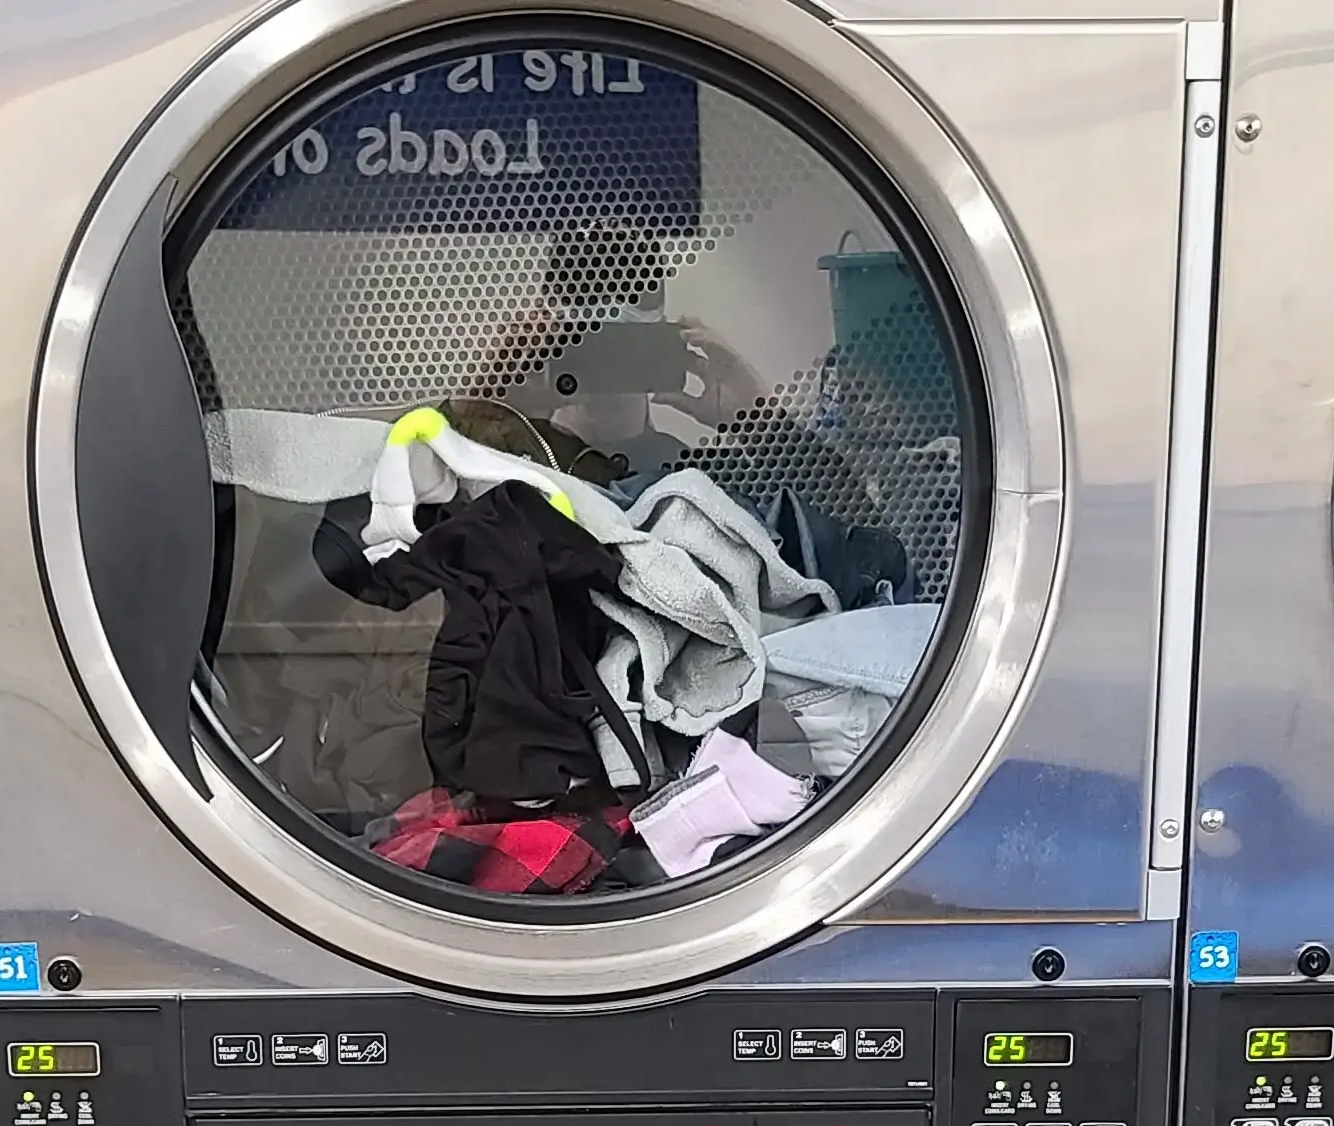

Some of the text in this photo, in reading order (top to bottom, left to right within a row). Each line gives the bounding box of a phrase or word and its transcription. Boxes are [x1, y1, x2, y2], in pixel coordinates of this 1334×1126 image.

[1199, 945, 1229, 968] 53
[341, 1035, 348, 1043] 3
[988, 1035, 1026, 1061] 25
[1250, 1031, 1287, 1057] 25
[17, 1044, 55, 1071] 25
